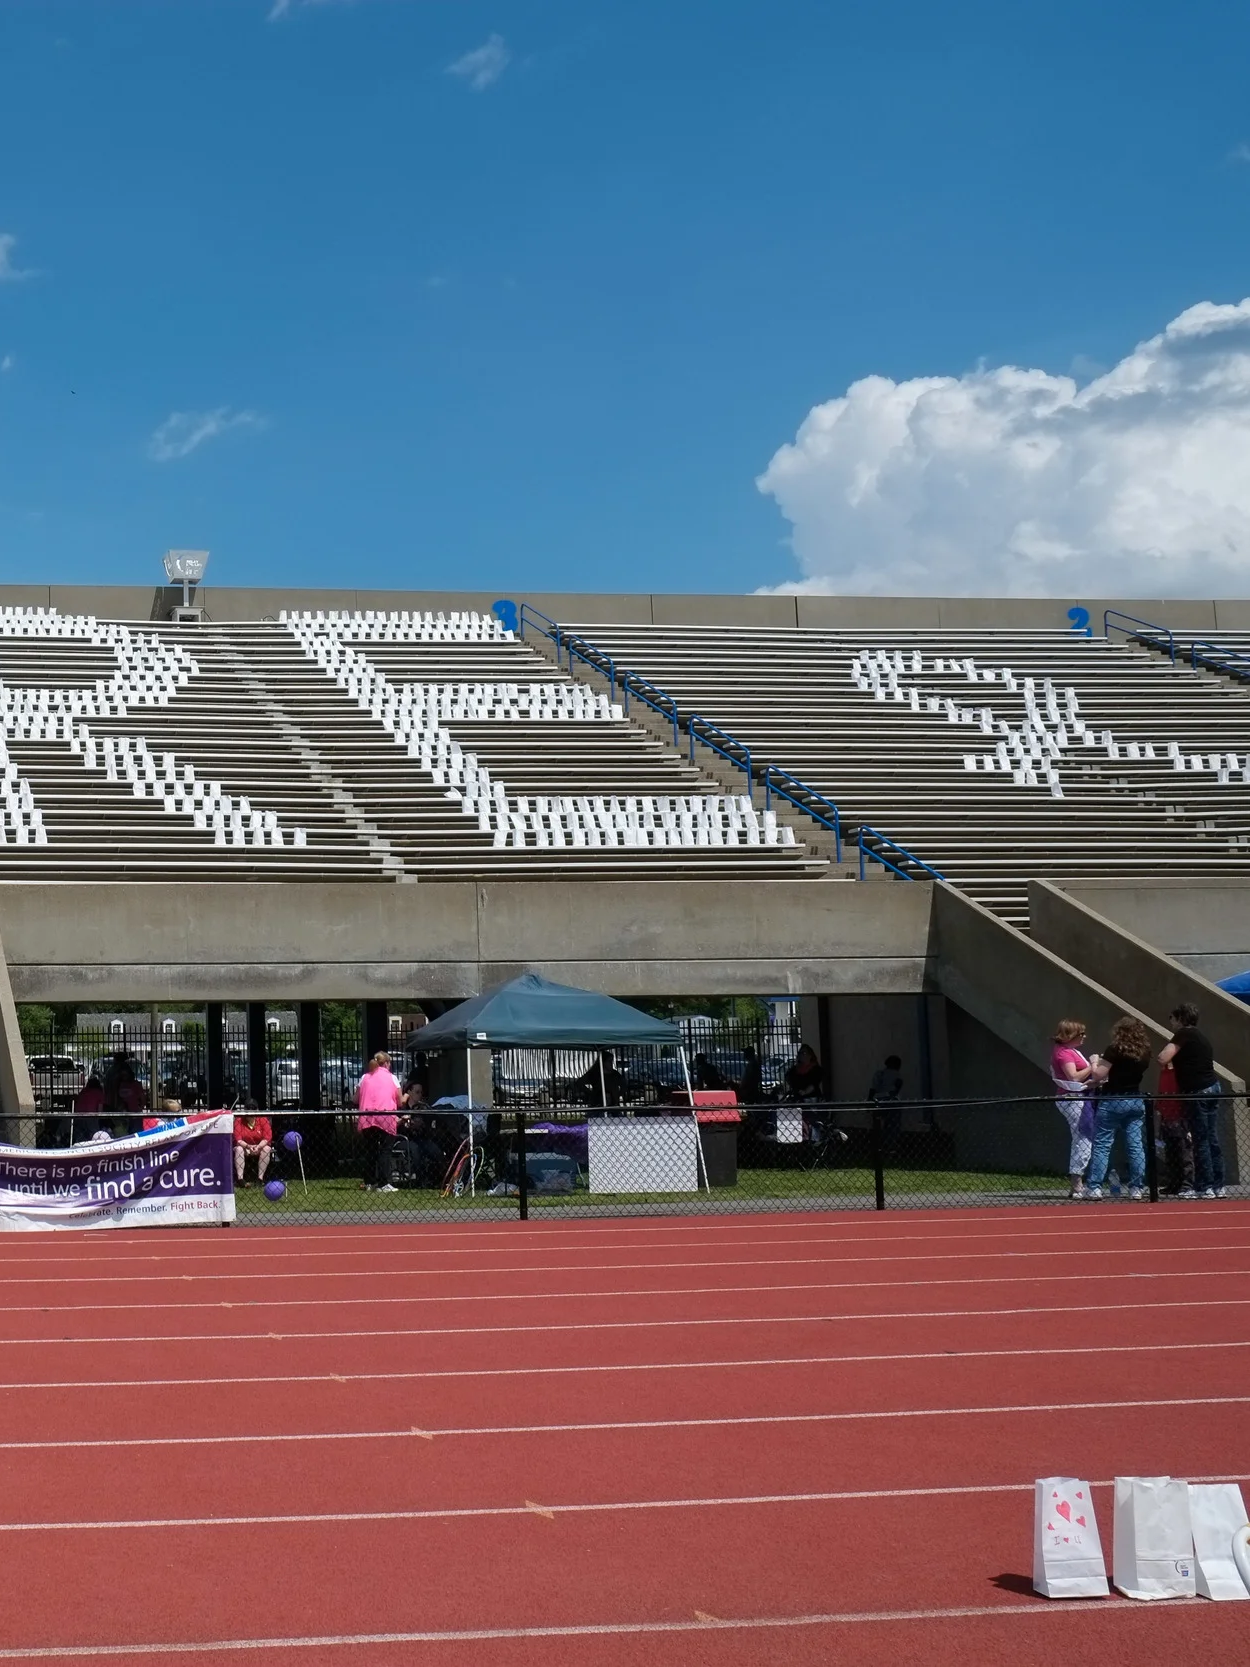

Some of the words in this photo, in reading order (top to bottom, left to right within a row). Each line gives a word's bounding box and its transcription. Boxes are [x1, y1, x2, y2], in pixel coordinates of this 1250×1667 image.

[492, 600, 518, 632] 3
[1067, 607, 1093, 638] 2
[52, 1164, 65, 1178] is
[70, 1165, 92, 1177] no
[97, 1153, 145, 1173] finish
[150, 1150, 180, 1167] line
[8, 1181, 48, 1196] until
[53, 1183, 81, 1197] we
[85, 1172, 136, 1200] find
[141, 1176, 154, 1191] a
[160, 1167, 221, 1189] cure.
[116, 1203, 168, 1215] Remember.
[170, 1201, 195, 1212] Fight
[197, 1200, 221, 1209] Back.
[1054, 1535, 1060, 1545] I
